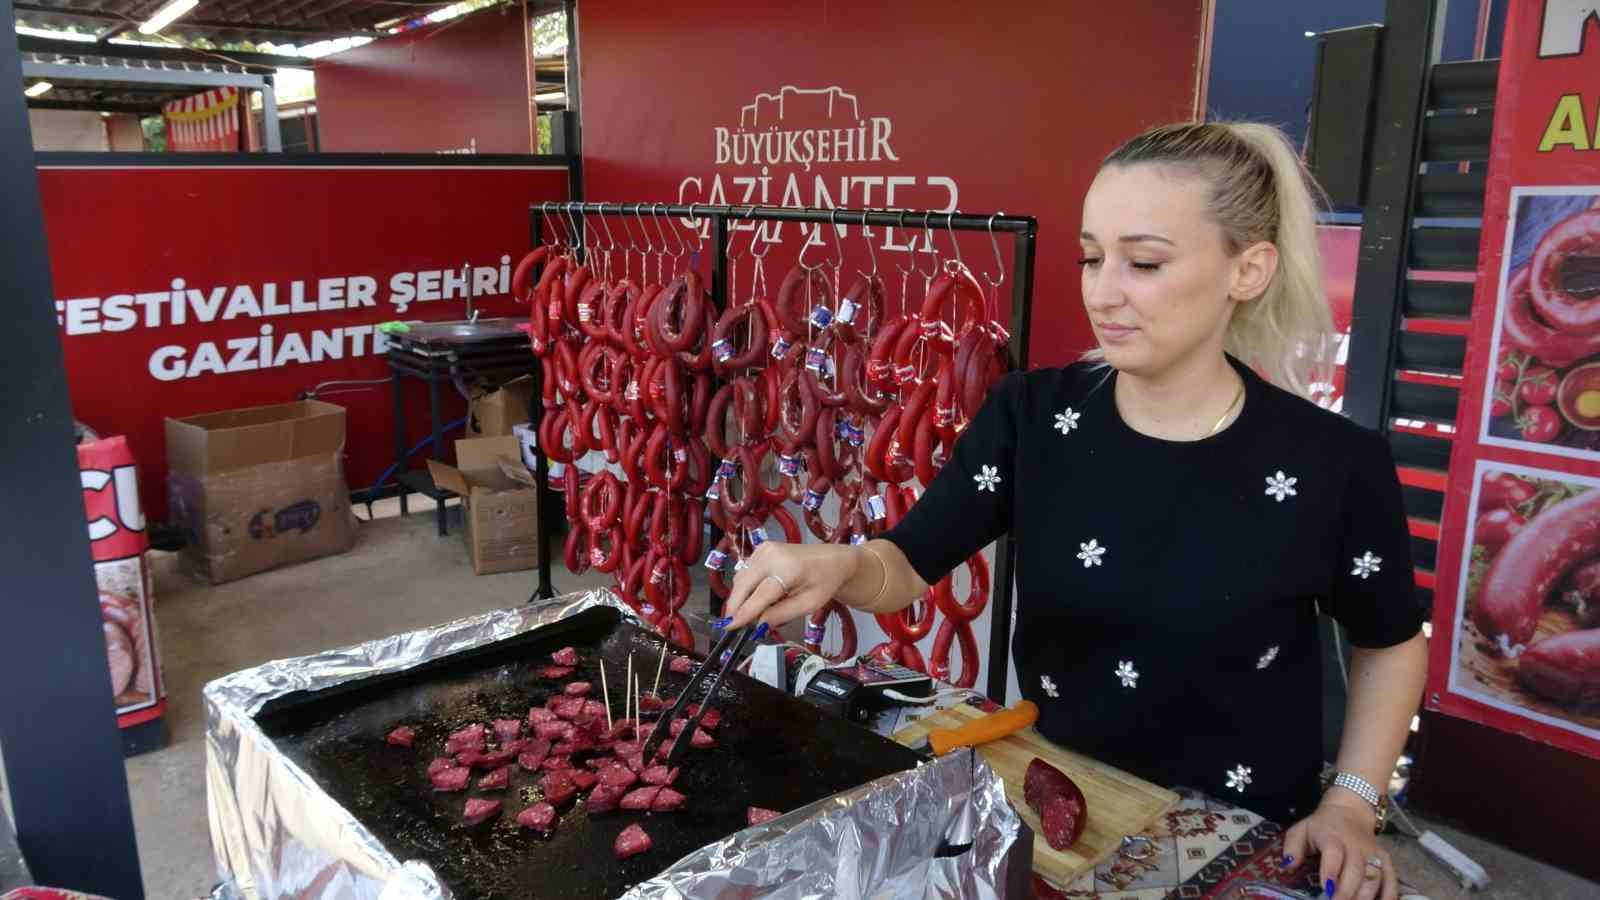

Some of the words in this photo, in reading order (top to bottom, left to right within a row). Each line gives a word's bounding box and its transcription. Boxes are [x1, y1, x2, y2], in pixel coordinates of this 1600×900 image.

[714, 117, 899, 172] BÜYÜKŞEHİR
[679, 166, 960, 253] GAZİANTEP
[55, 276, 377, 336] ESTİVALLER
[390, 254, 511, 313] ŞEHRİ
[148, 322, 408, 381] GAZİANTE
